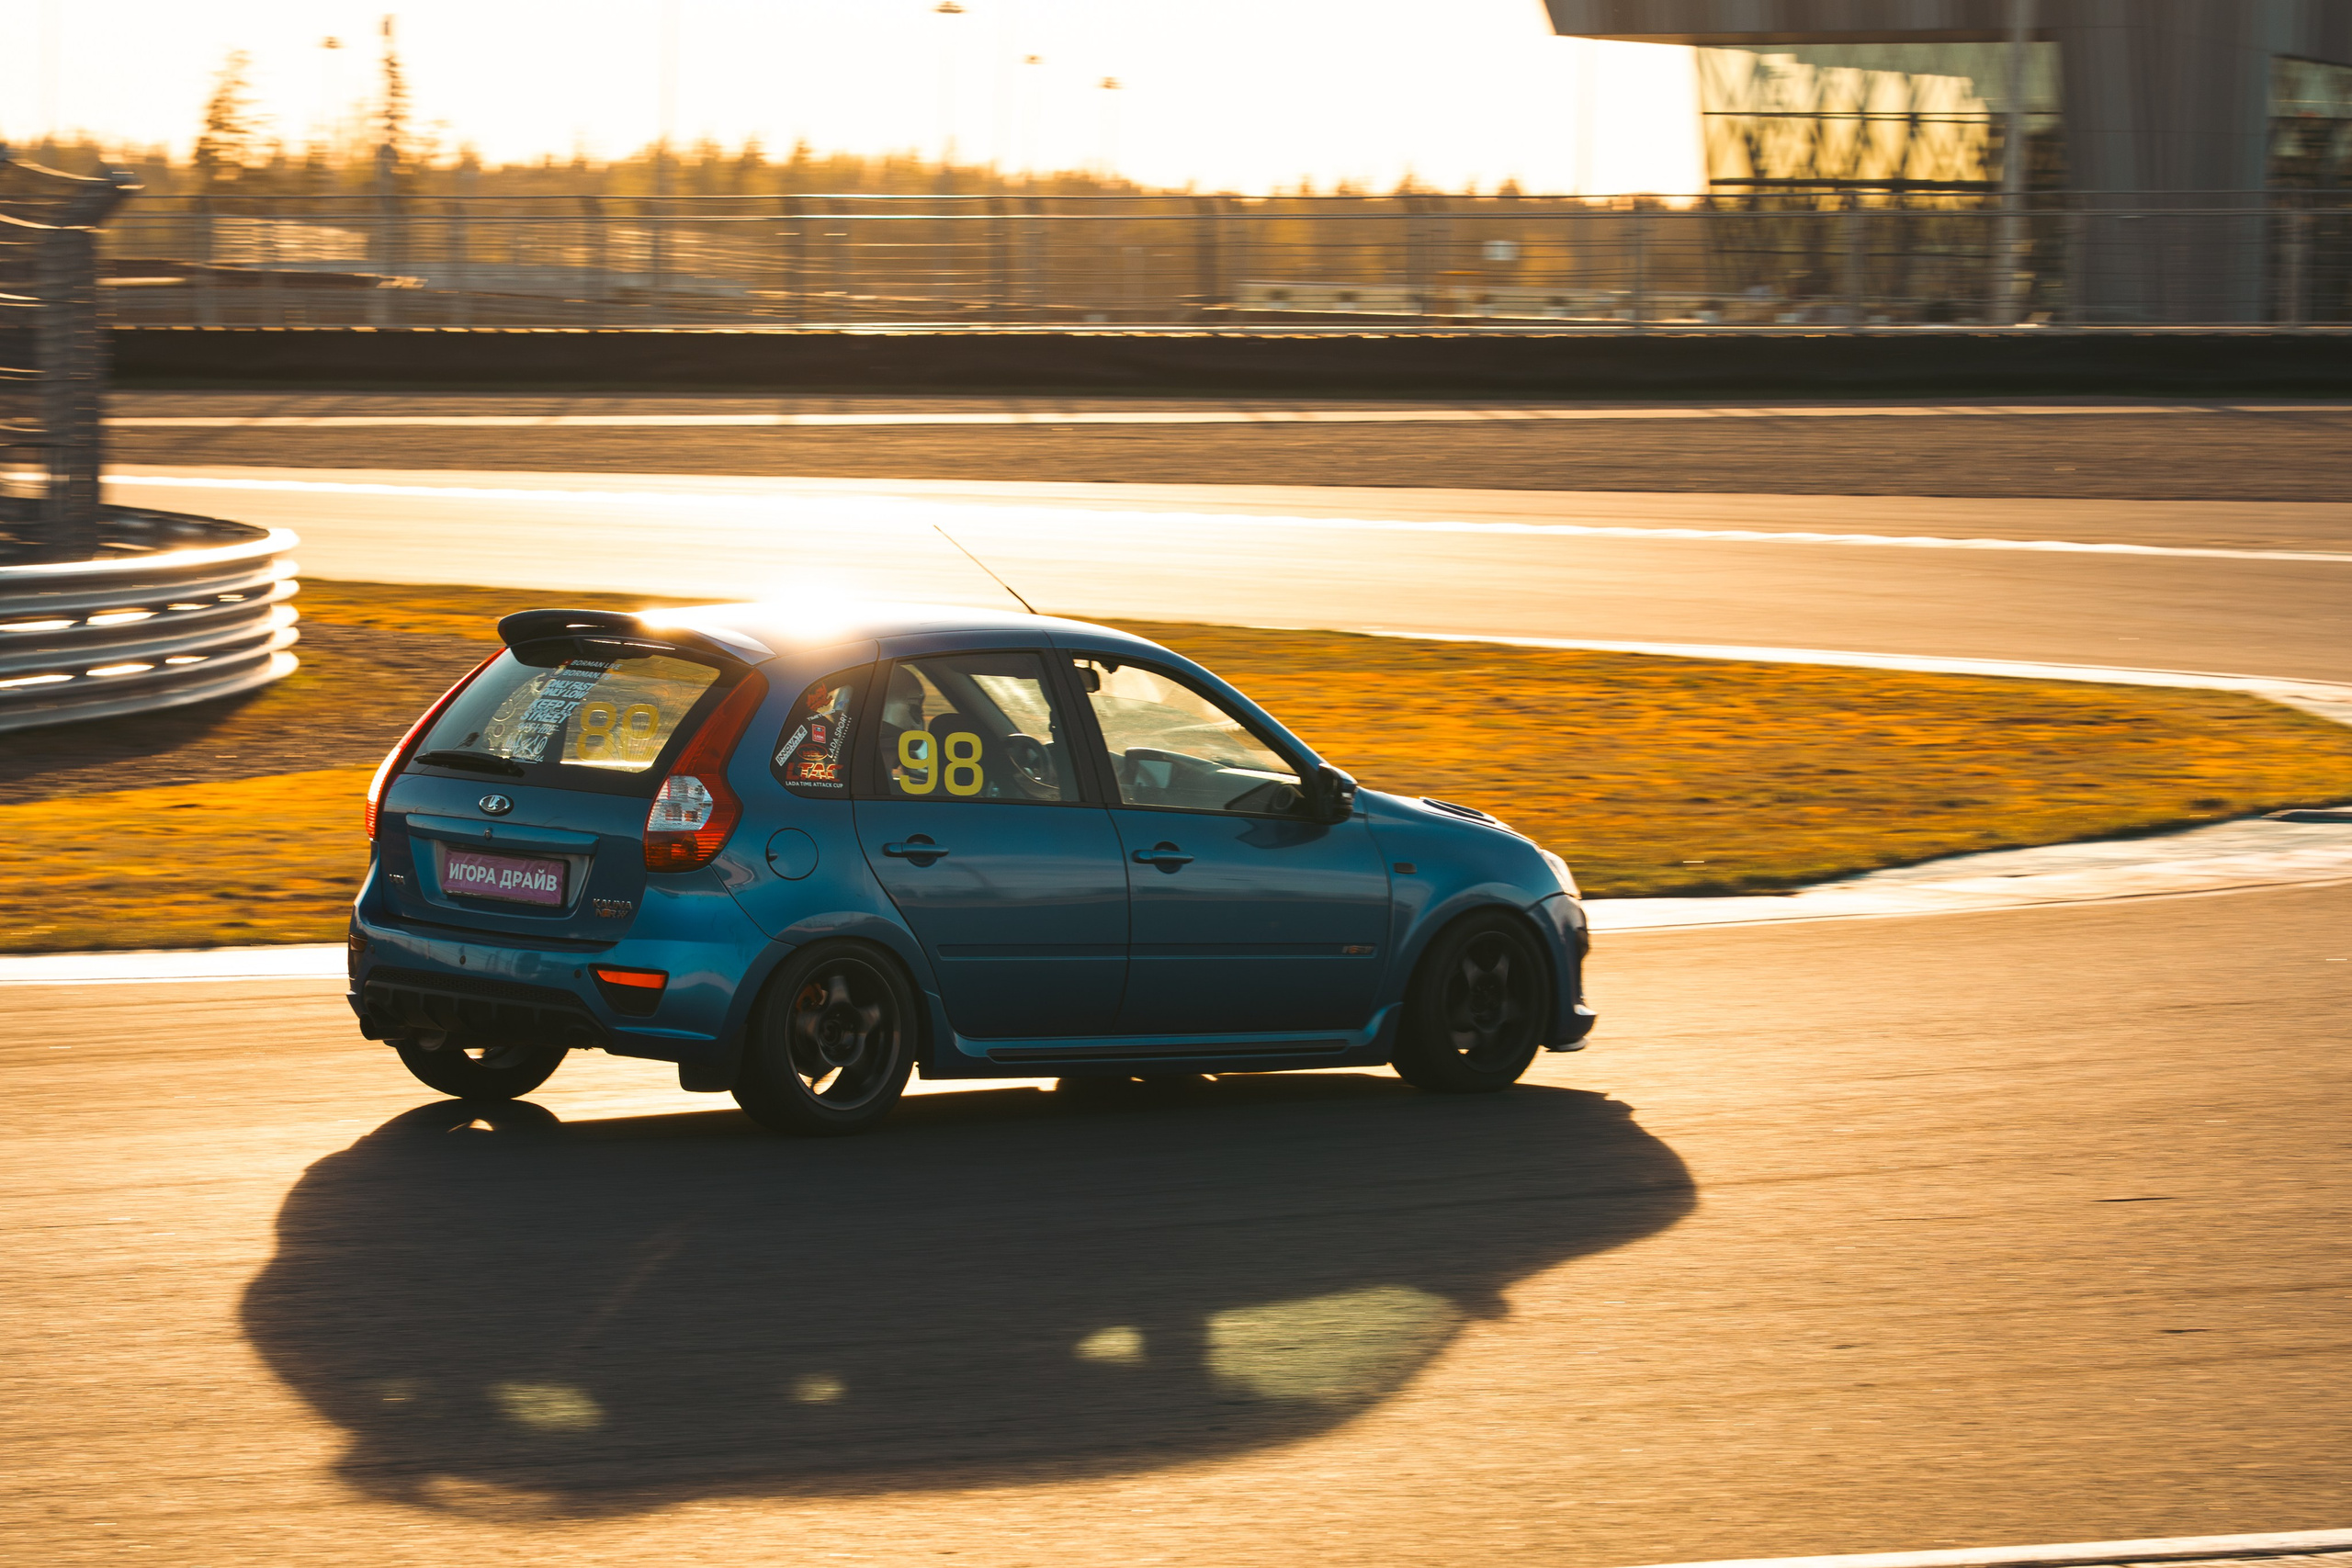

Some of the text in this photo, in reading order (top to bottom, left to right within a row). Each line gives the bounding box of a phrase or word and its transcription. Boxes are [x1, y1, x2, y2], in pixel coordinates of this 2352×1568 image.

[570, 660, 623, 671] BORMAN LIVE
[548, 679, 596, 691] ONLY FAST
[539, 687, 590, 699] ONLY LOW
[528, 698, 581, 711] KEEP IT
[520, 710, 570, 724] STREET
[827, 738, 840, 759] LADA
[834, 713, 848, 738] SPORT
[776, 726, 805, 763] INNOVATE
[899, 730, 983, 795] 98
[449, 862, 559, 892] ИГОРА ДРАЙВ
